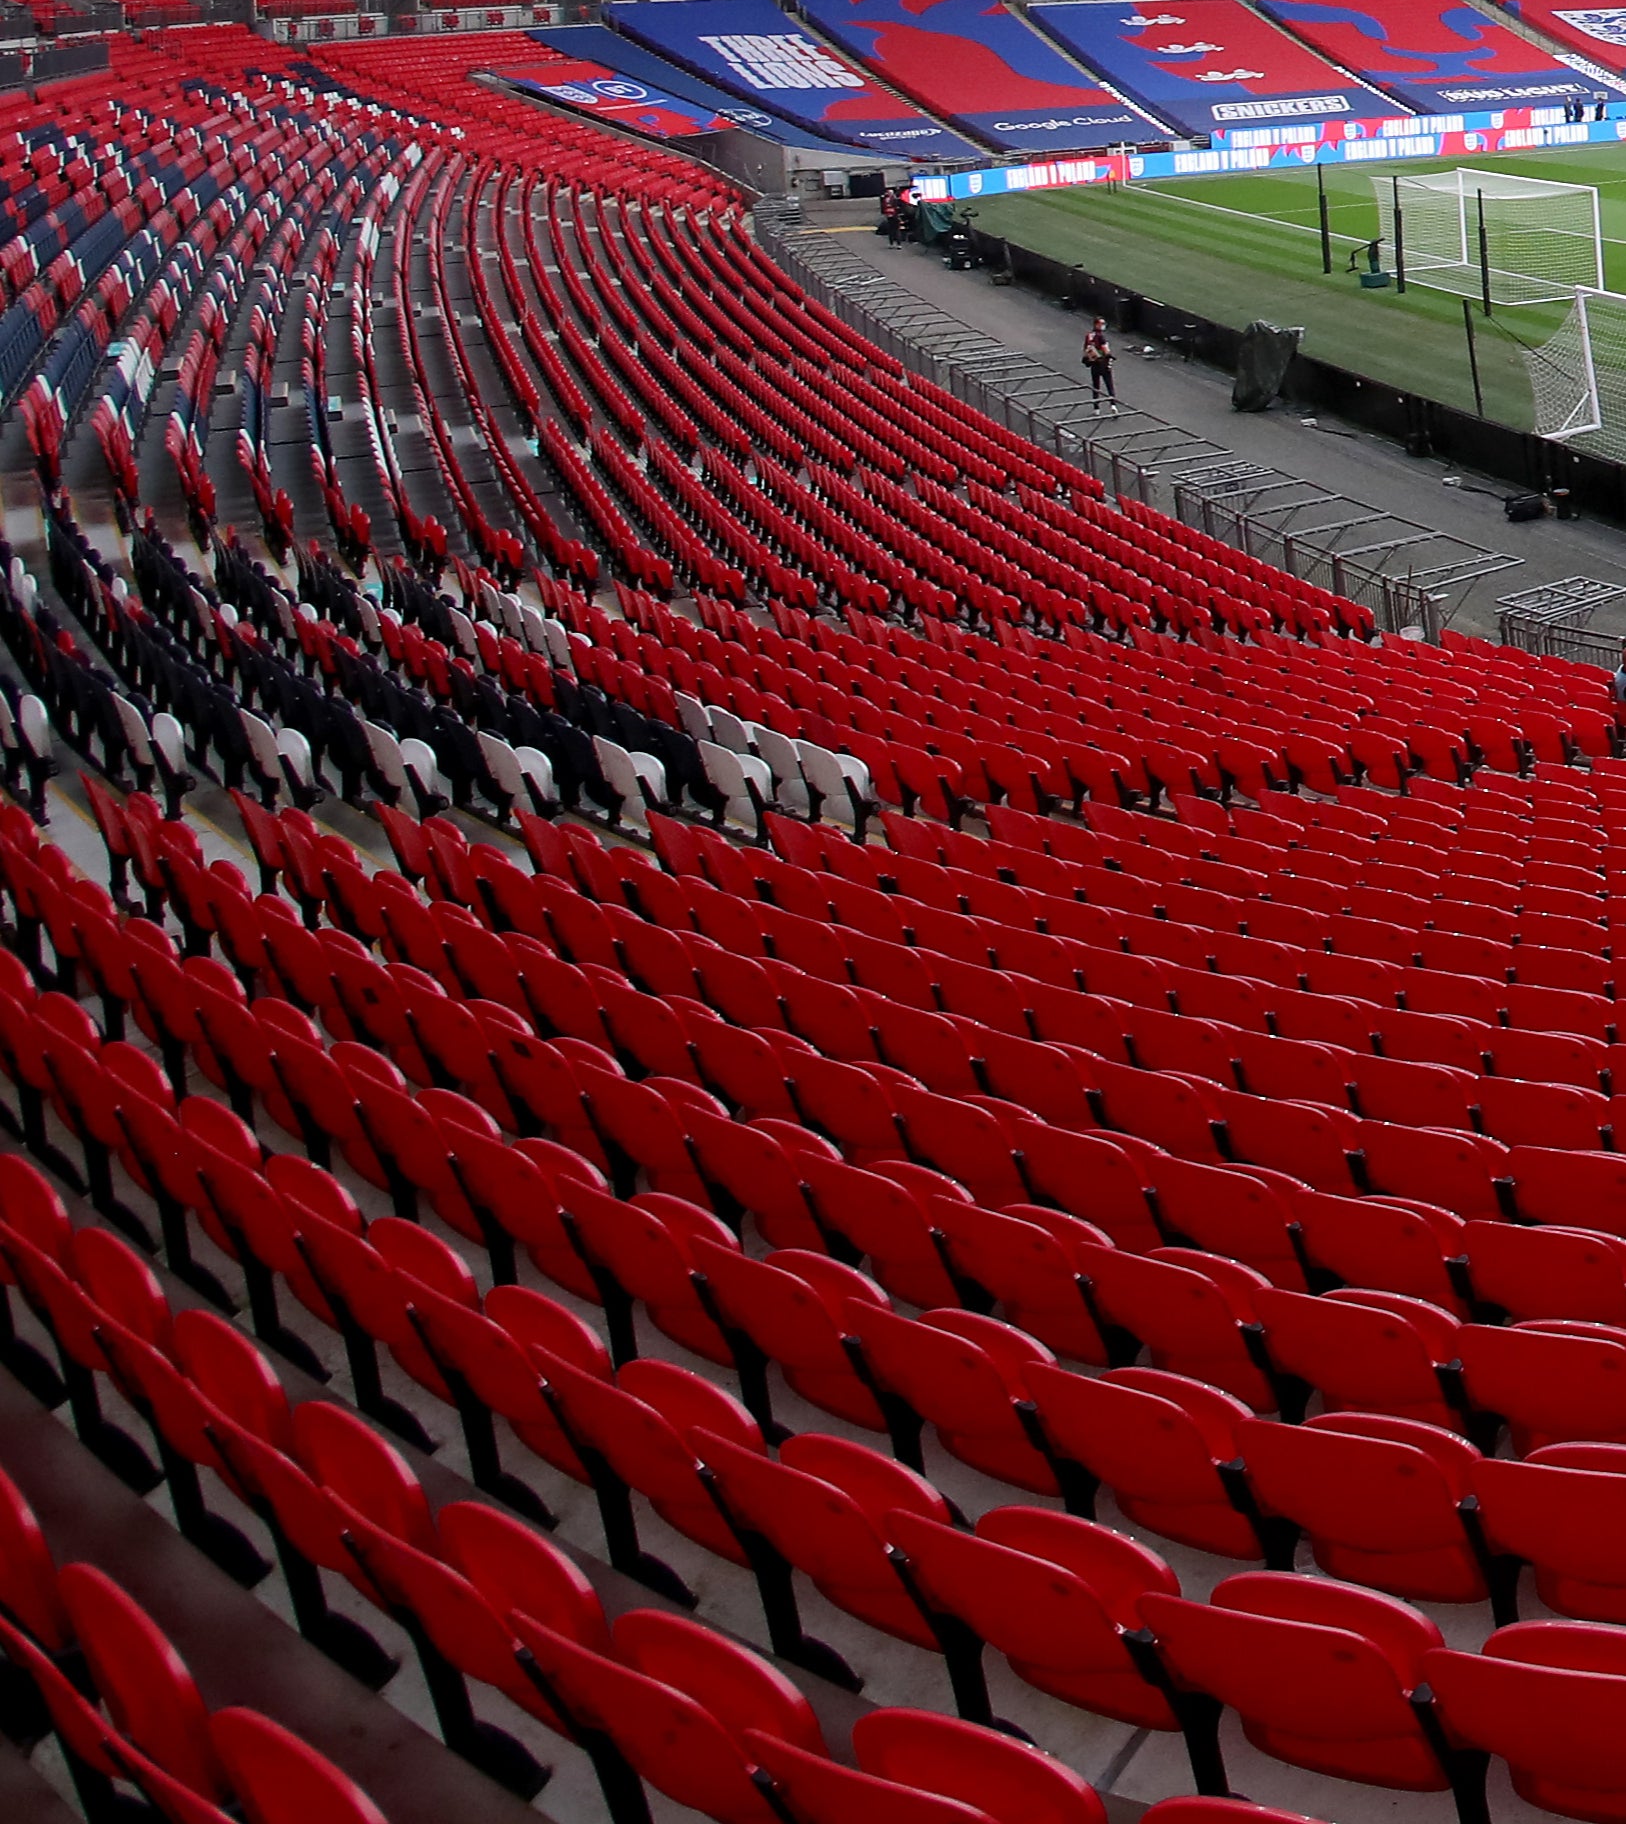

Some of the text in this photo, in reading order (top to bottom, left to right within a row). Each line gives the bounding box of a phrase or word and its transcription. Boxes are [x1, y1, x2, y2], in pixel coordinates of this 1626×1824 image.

[698, 33, 829, 63] THREE
[727, 60, 864, 90] LIONS
[1447, 82, 1581, 103] BUD LIGHT
[1218, 98, 1345, 118] SNICKERS
[993, 114, 1132, 132] Google Cloud
